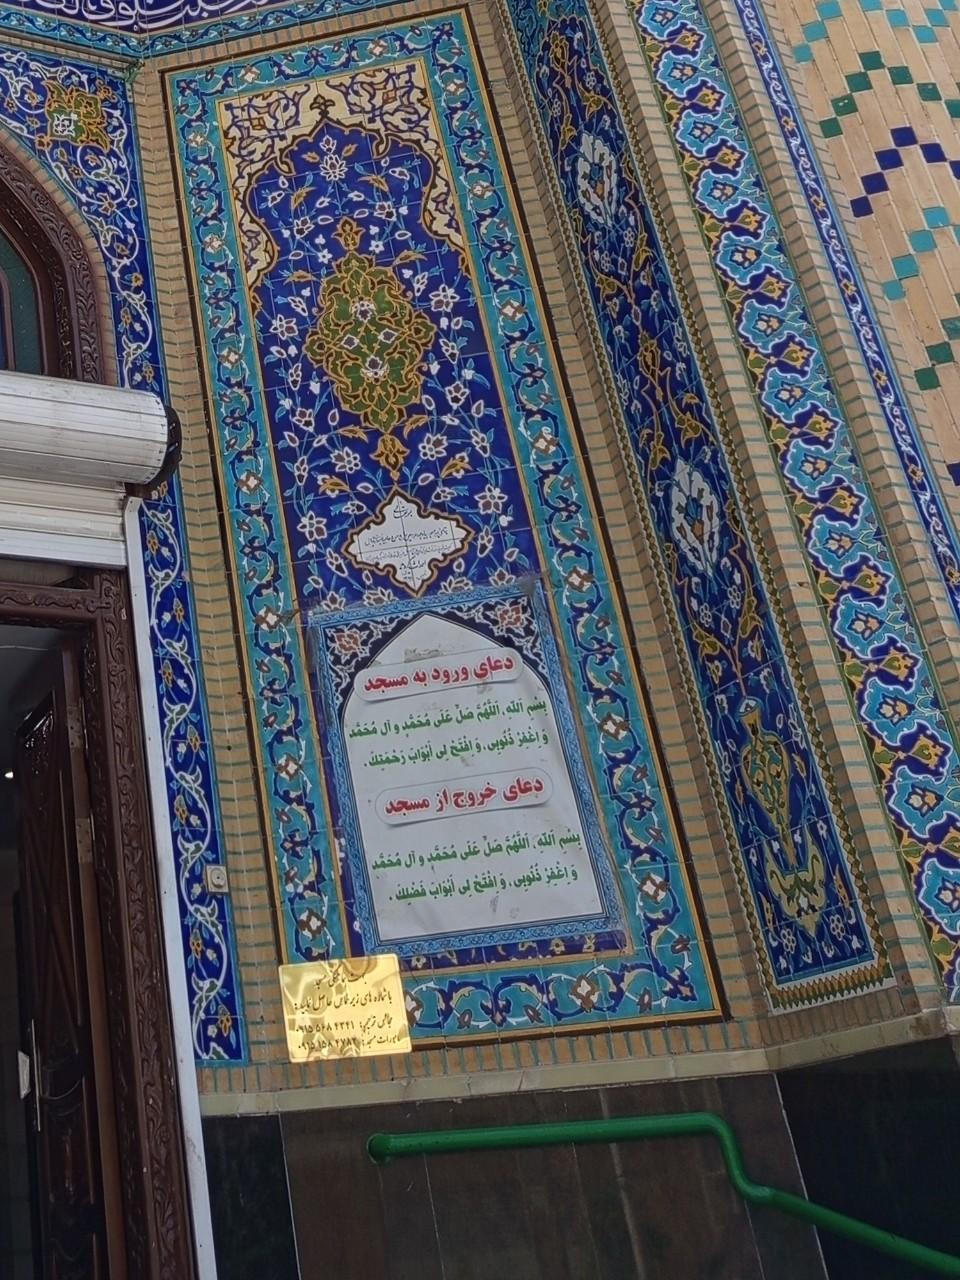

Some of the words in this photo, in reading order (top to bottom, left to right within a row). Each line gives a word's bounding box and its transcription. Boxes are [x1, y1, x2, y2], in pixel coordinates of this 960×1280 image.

[432, 665, 469, 684] ورود
[474, 656, 514, 679] دعای
[364, 674, 409, 693] مسجد
[413, 671, 427, 686] به
[453, 782, 496, 808] خروج
[503, 777, 544, 801] دعای
[386, 798, 430, 815] مسجد
[436, 789, 448, 812] از
